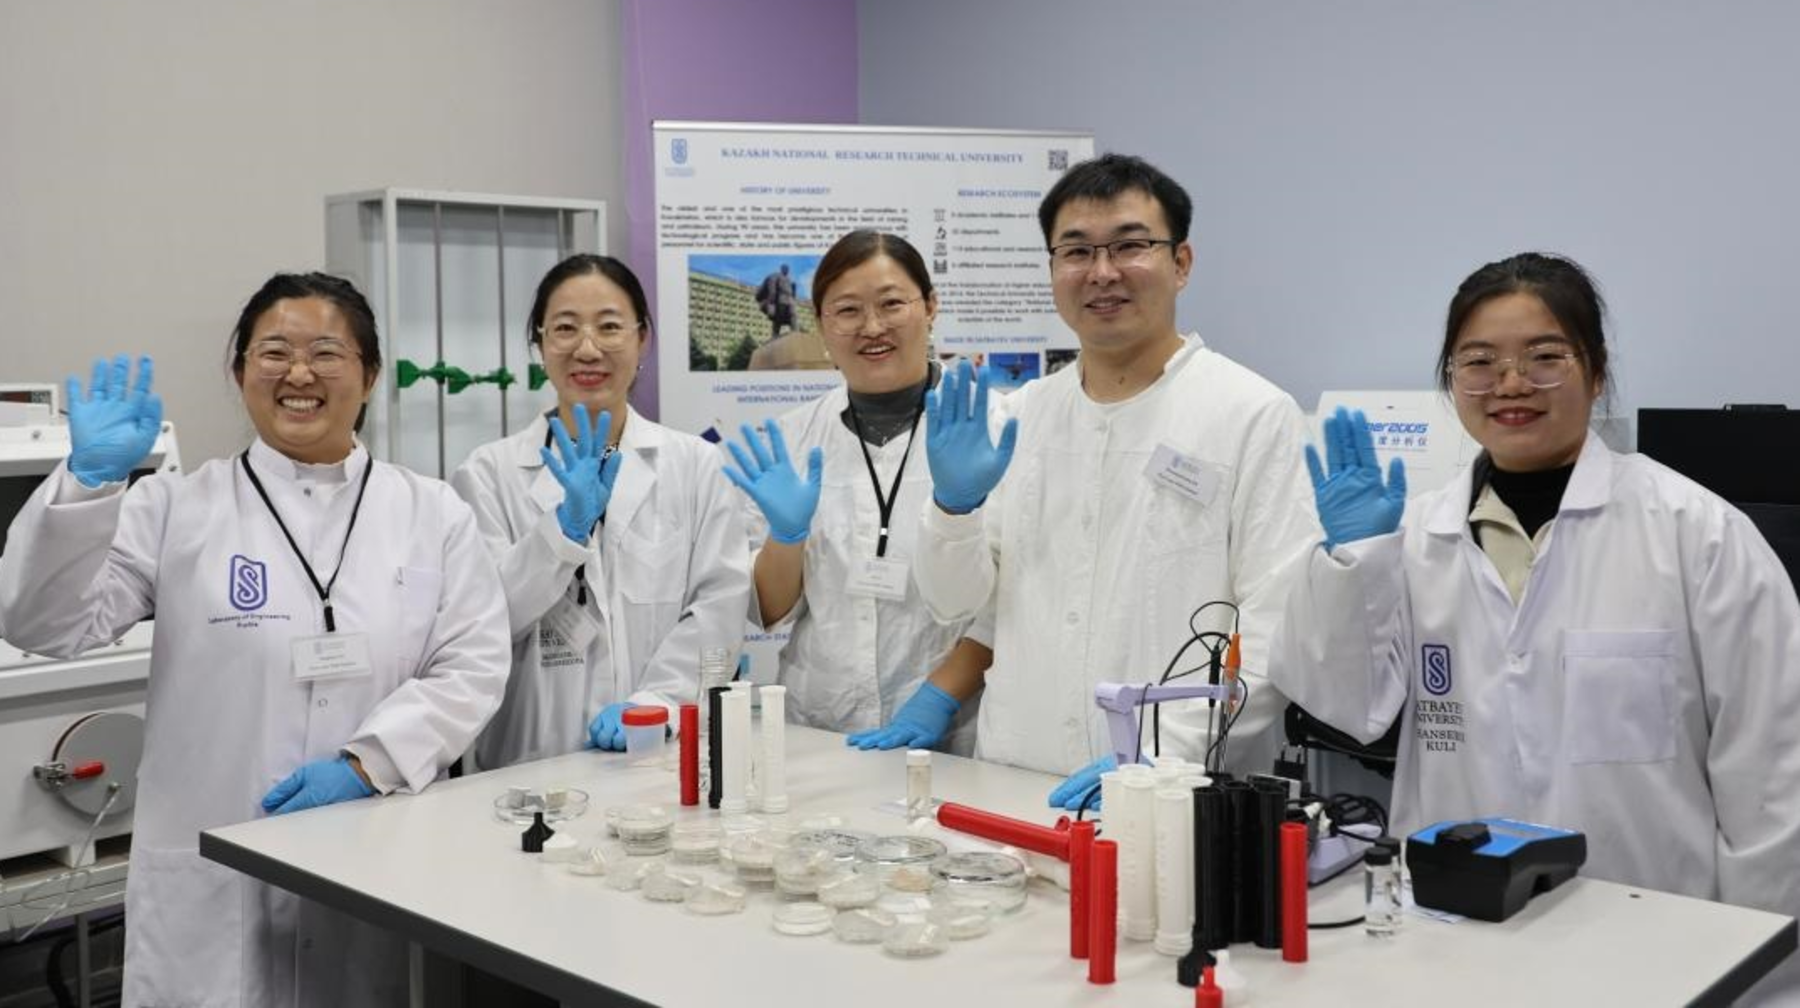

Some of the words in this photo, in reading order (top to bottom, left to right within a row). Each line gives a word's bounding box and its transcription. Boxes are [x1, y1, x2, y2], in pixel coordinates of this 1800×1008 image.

[721, 148, 770, 158] KAZAKH
[772, 149, 829, 159] NATIONAL
[835, 150, 893, 160] RESEARCH
[897, 151, 956, 162] TECHNICAL
[960, 152, 1024, 164] UNIVERSITY
